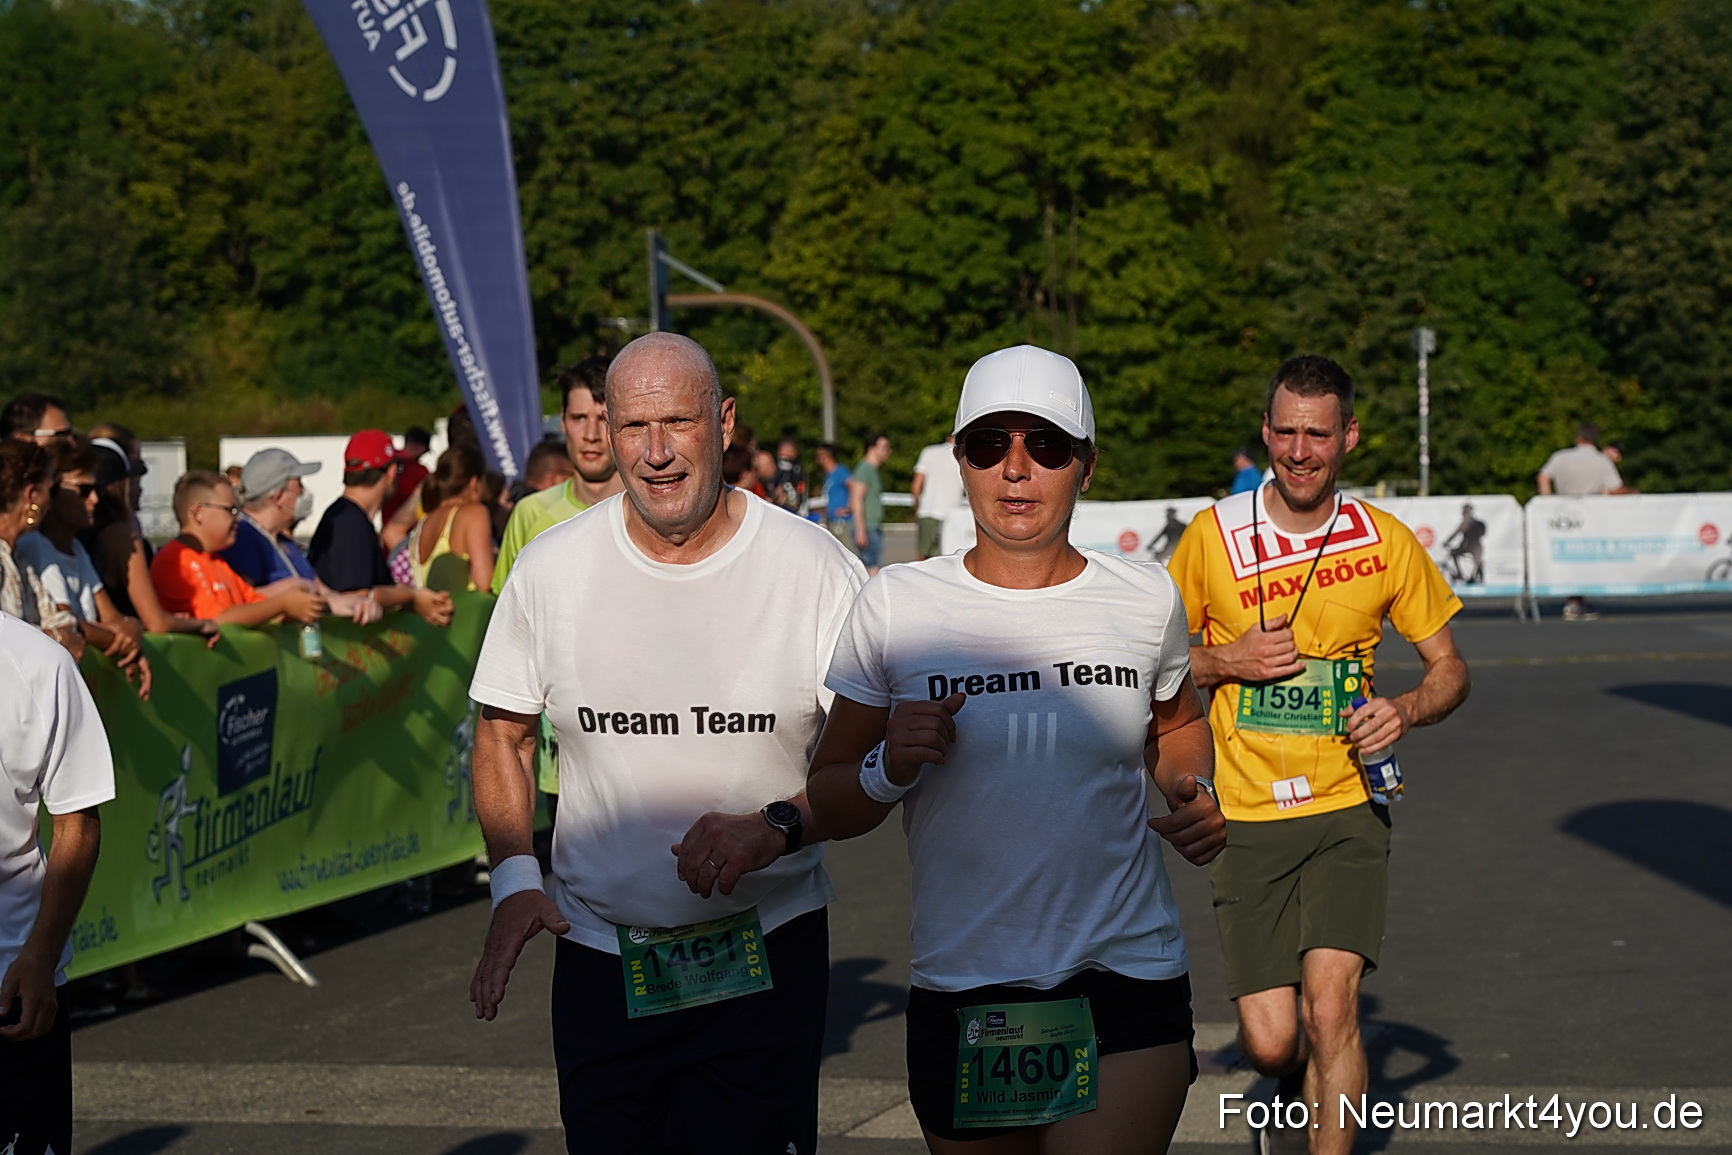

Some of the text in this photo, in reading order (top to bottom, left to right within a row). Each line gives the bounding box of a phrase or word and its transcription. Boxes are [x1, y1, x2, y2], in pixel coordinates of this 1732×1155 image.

[1238, 554, 1388, 610] MAX BÖGL
[927, 661, 1139, 701] Dream Team
[1255, 685, 1322, 710] 1594
[577, 705, 777, 735] Dream Team
[1242, 688, 1253, 716] RUN
[1251, 708, 1323, 721] Schiller Christian
[1322, 689, 1332, 725] 2022
[194, 744, 323, 862] firmenlauf
[643, 930, 737, 978] 1461
[742, 928, 763, 977] 2022
[630, 959, 647, 997] RUN
[646, 964, 749, 995] Brede Wolfgang
[980, 1025, 1025, 1038] Firmenlauf
[995, 1033, 1025, 1042] neumarkt
[960, 1061, 971, 1104] RUN
[971, 1043, 1070, 1087] 1460
[1073, 1046, 1090, 1099] 2022
[976, 1088, 1064, 1104] Wild Jasmin
